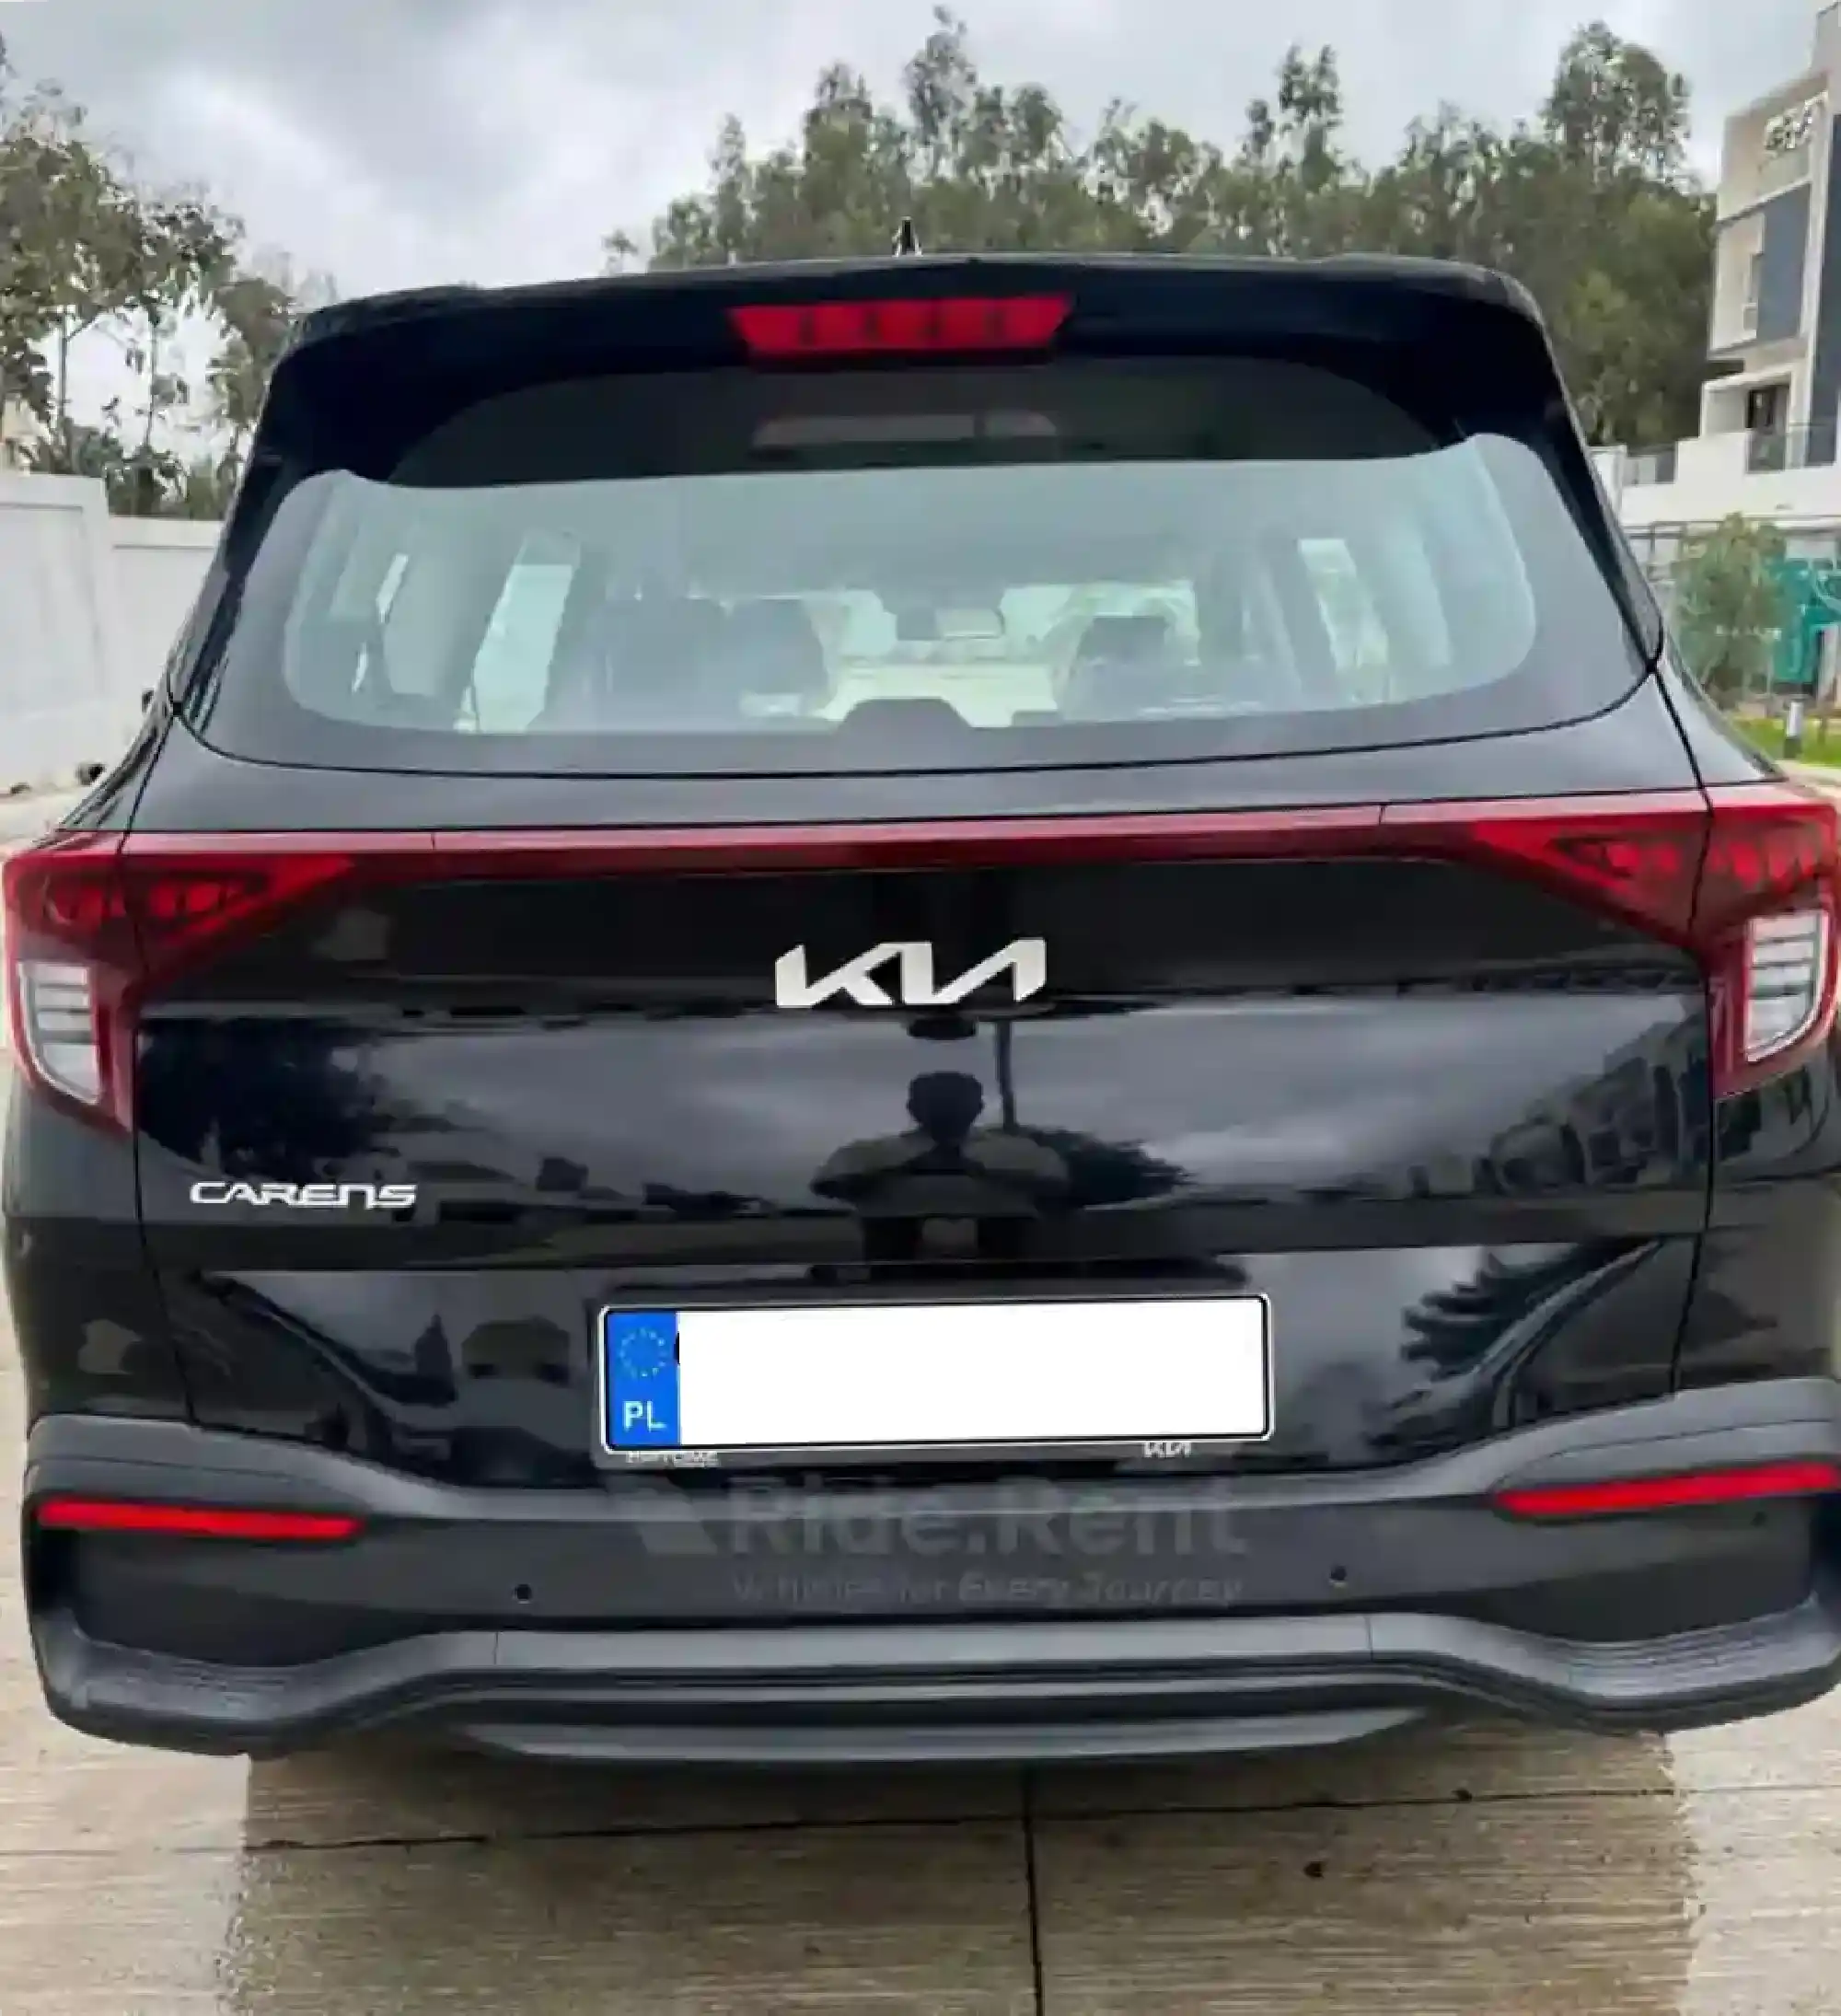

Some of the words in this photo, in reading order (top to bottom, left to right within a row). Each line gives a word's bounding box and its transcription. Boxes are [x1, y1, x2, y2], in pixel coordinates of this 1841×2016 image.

[775, 937, 1047, 1008] KIA
[190, 1181, 417, 1209] CARENS
[623, 1400, 666, 1431] PL
